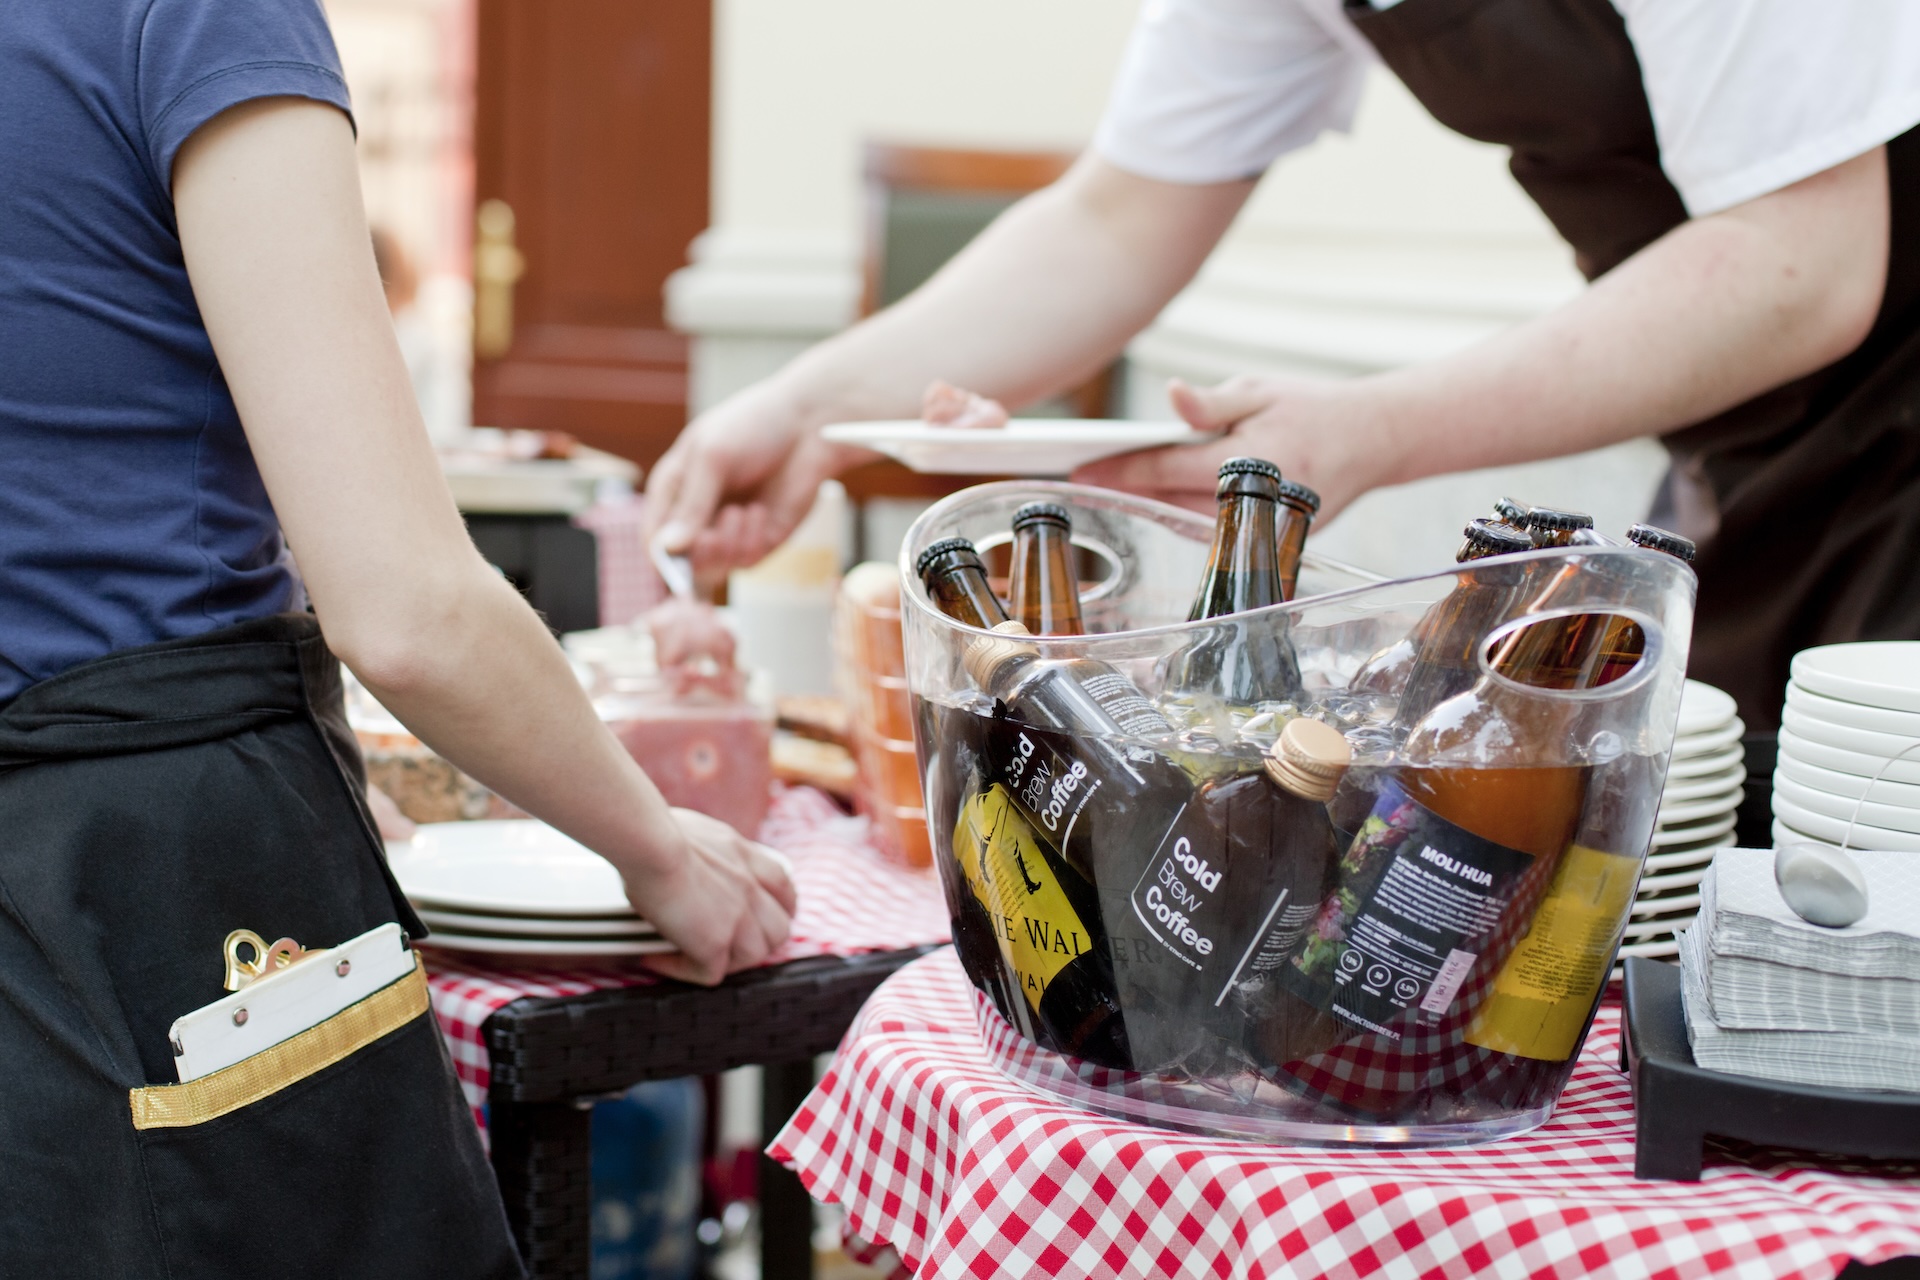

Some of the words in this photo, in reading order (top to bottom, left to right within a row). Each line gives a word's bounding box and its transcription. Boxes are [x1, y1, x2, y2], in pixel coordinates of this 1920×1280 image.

[1021, 760, 1051, 812] Brew
[1041, 761, 1087, 831] Coffee
[1158, 858, 1203, 912] Brew
[1174, 836, 1222, 893] Cold
[1420, 845, 1461, 874] MOLI
[1459, 864, 1492, 887] HUA
[1146, 885, 1213, 955] Coffee
